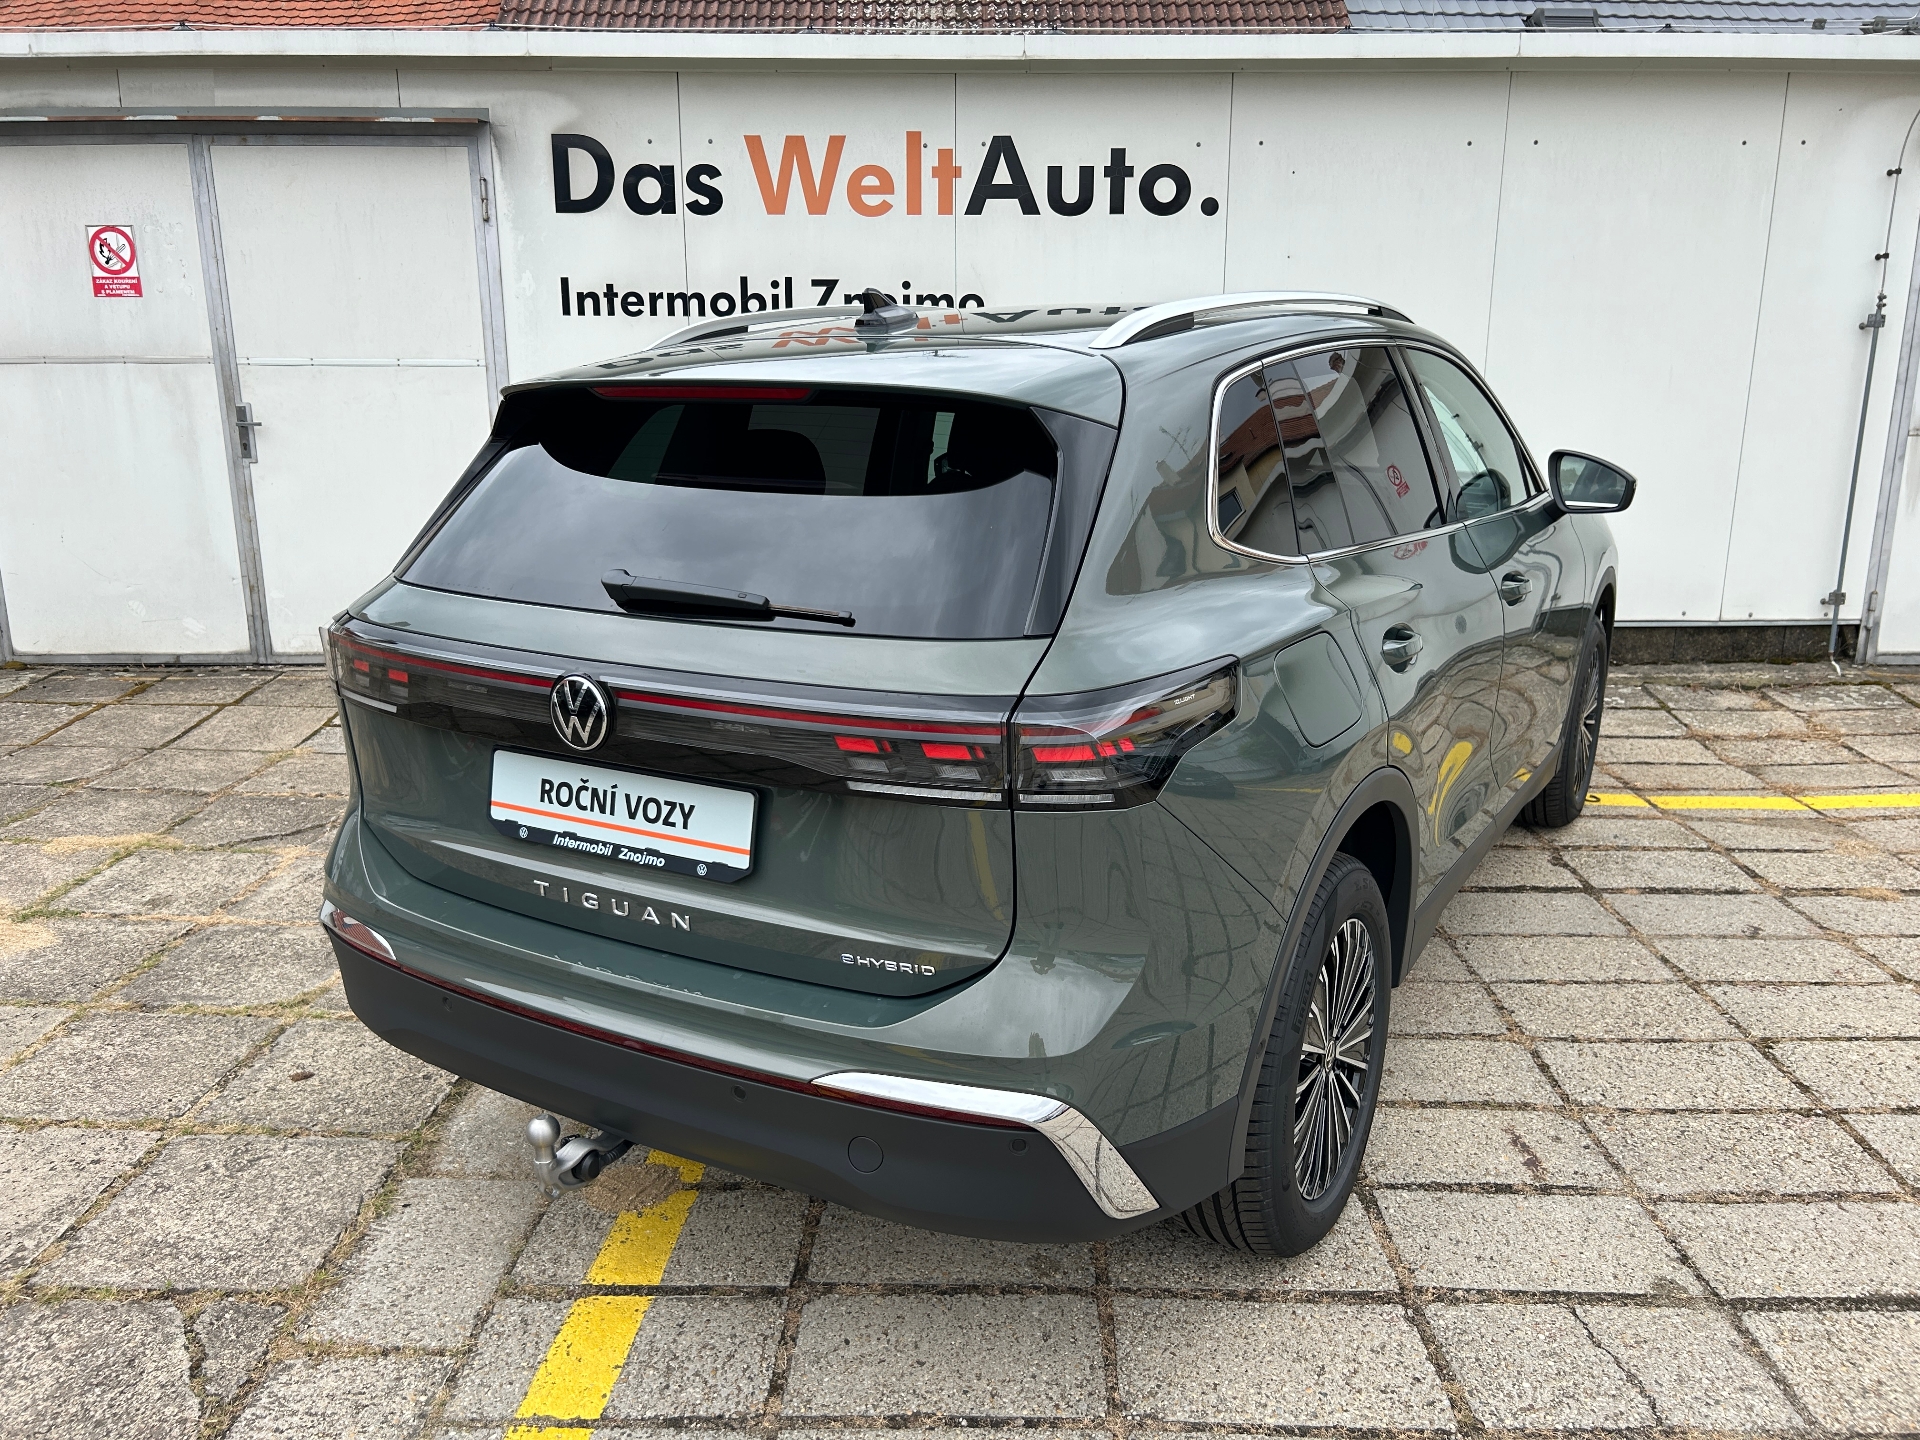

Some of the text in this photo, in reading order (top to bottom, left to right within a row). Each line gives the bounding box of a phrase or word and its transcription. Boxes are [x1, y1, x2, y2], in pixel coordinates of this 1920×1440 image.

[550, 133, 724, 216] Das
[560, 276, 793, 318] Intermobil
[540, 777, 696, 830] ROČNÍ VOZY
[552, 833, 666, 868] Intermobil Znojmo
[533, 879, 692, 933] TIGUAN
